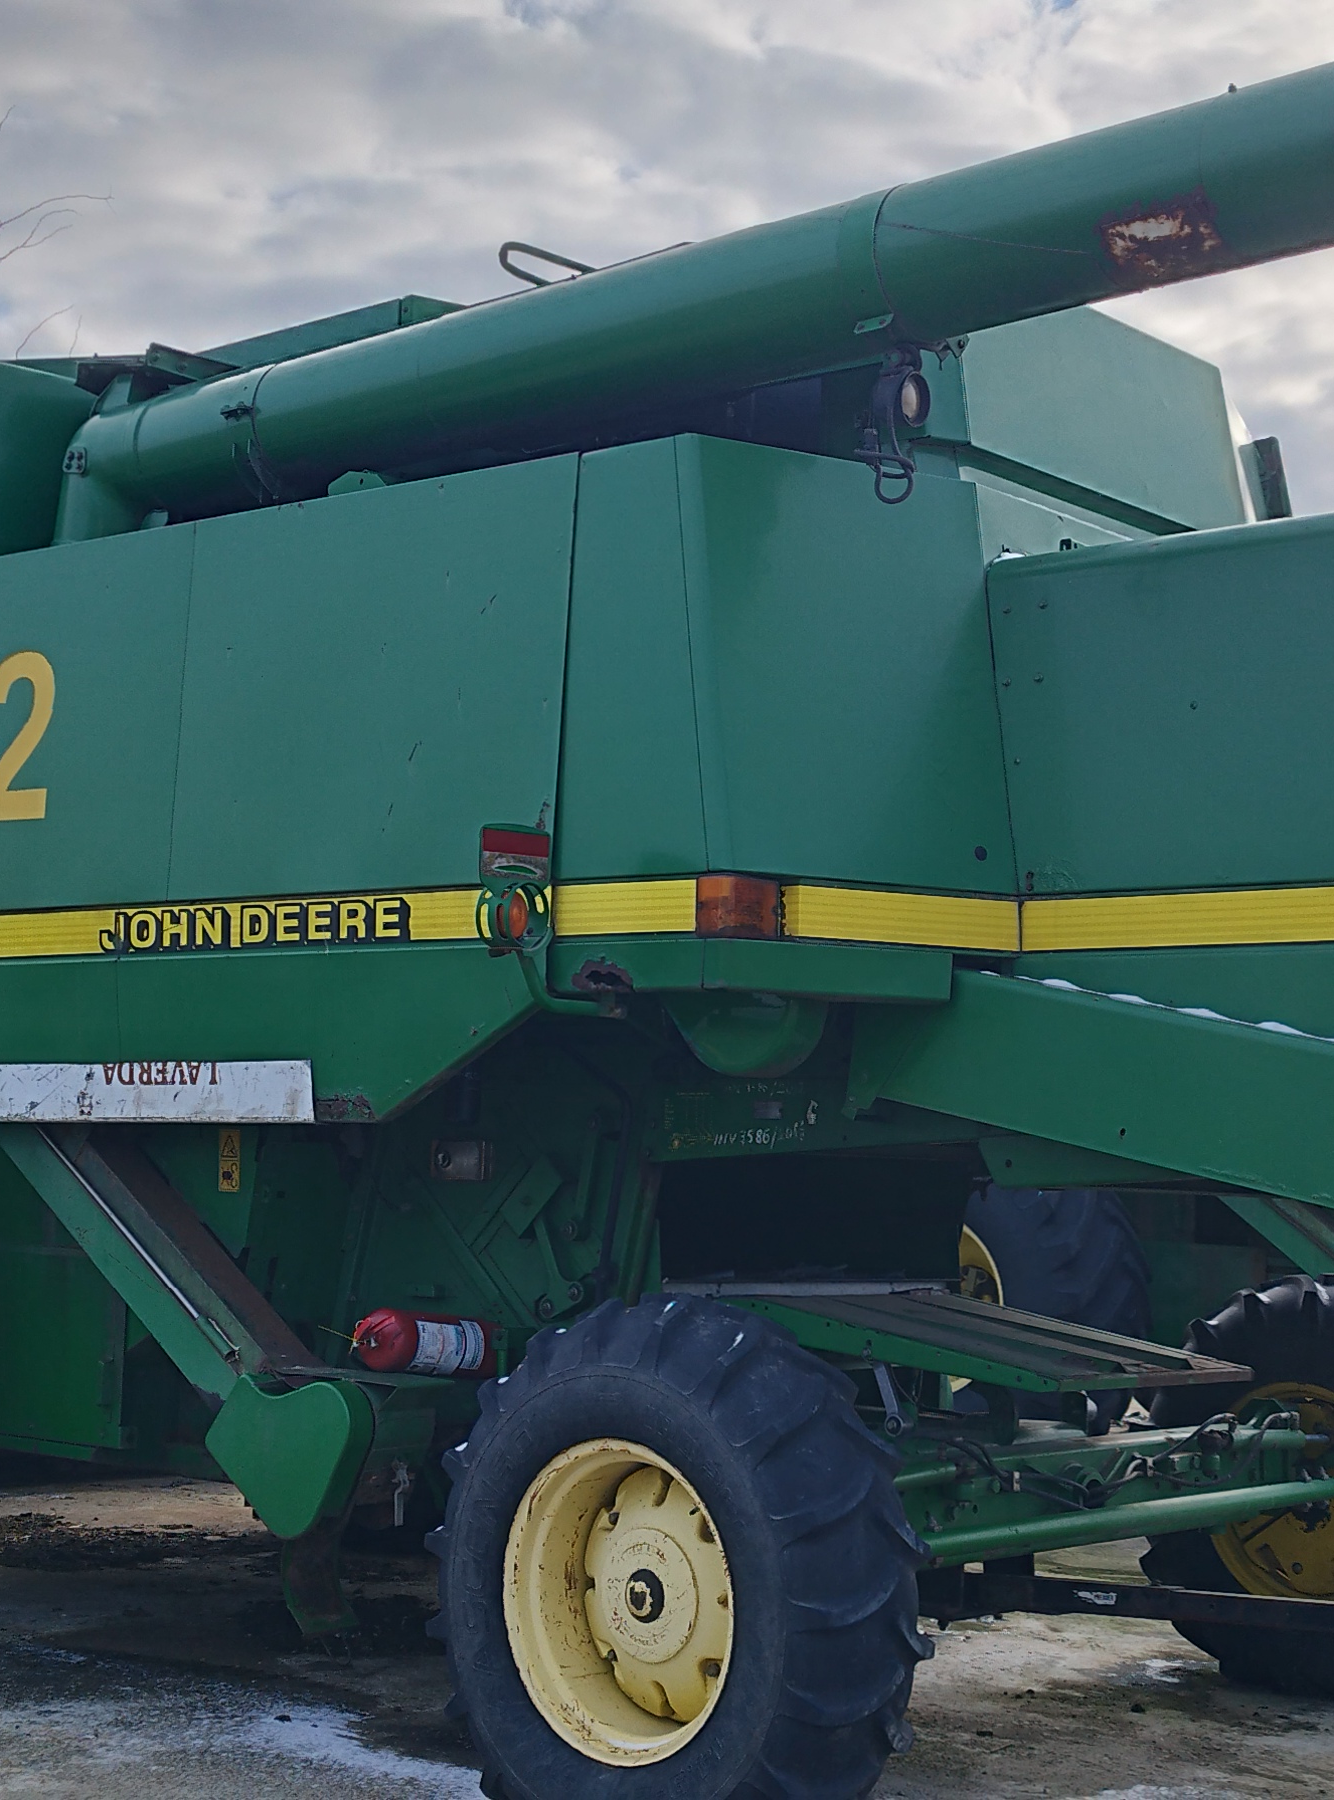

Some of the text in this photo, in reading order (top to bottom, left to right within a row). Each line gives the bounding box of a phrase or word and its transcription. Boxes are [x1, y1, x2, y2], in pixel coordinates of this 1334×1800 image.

[99, 898, 409, 952] JOHN DEERE
[101, 1061, 218, 1086] LAVERDA
